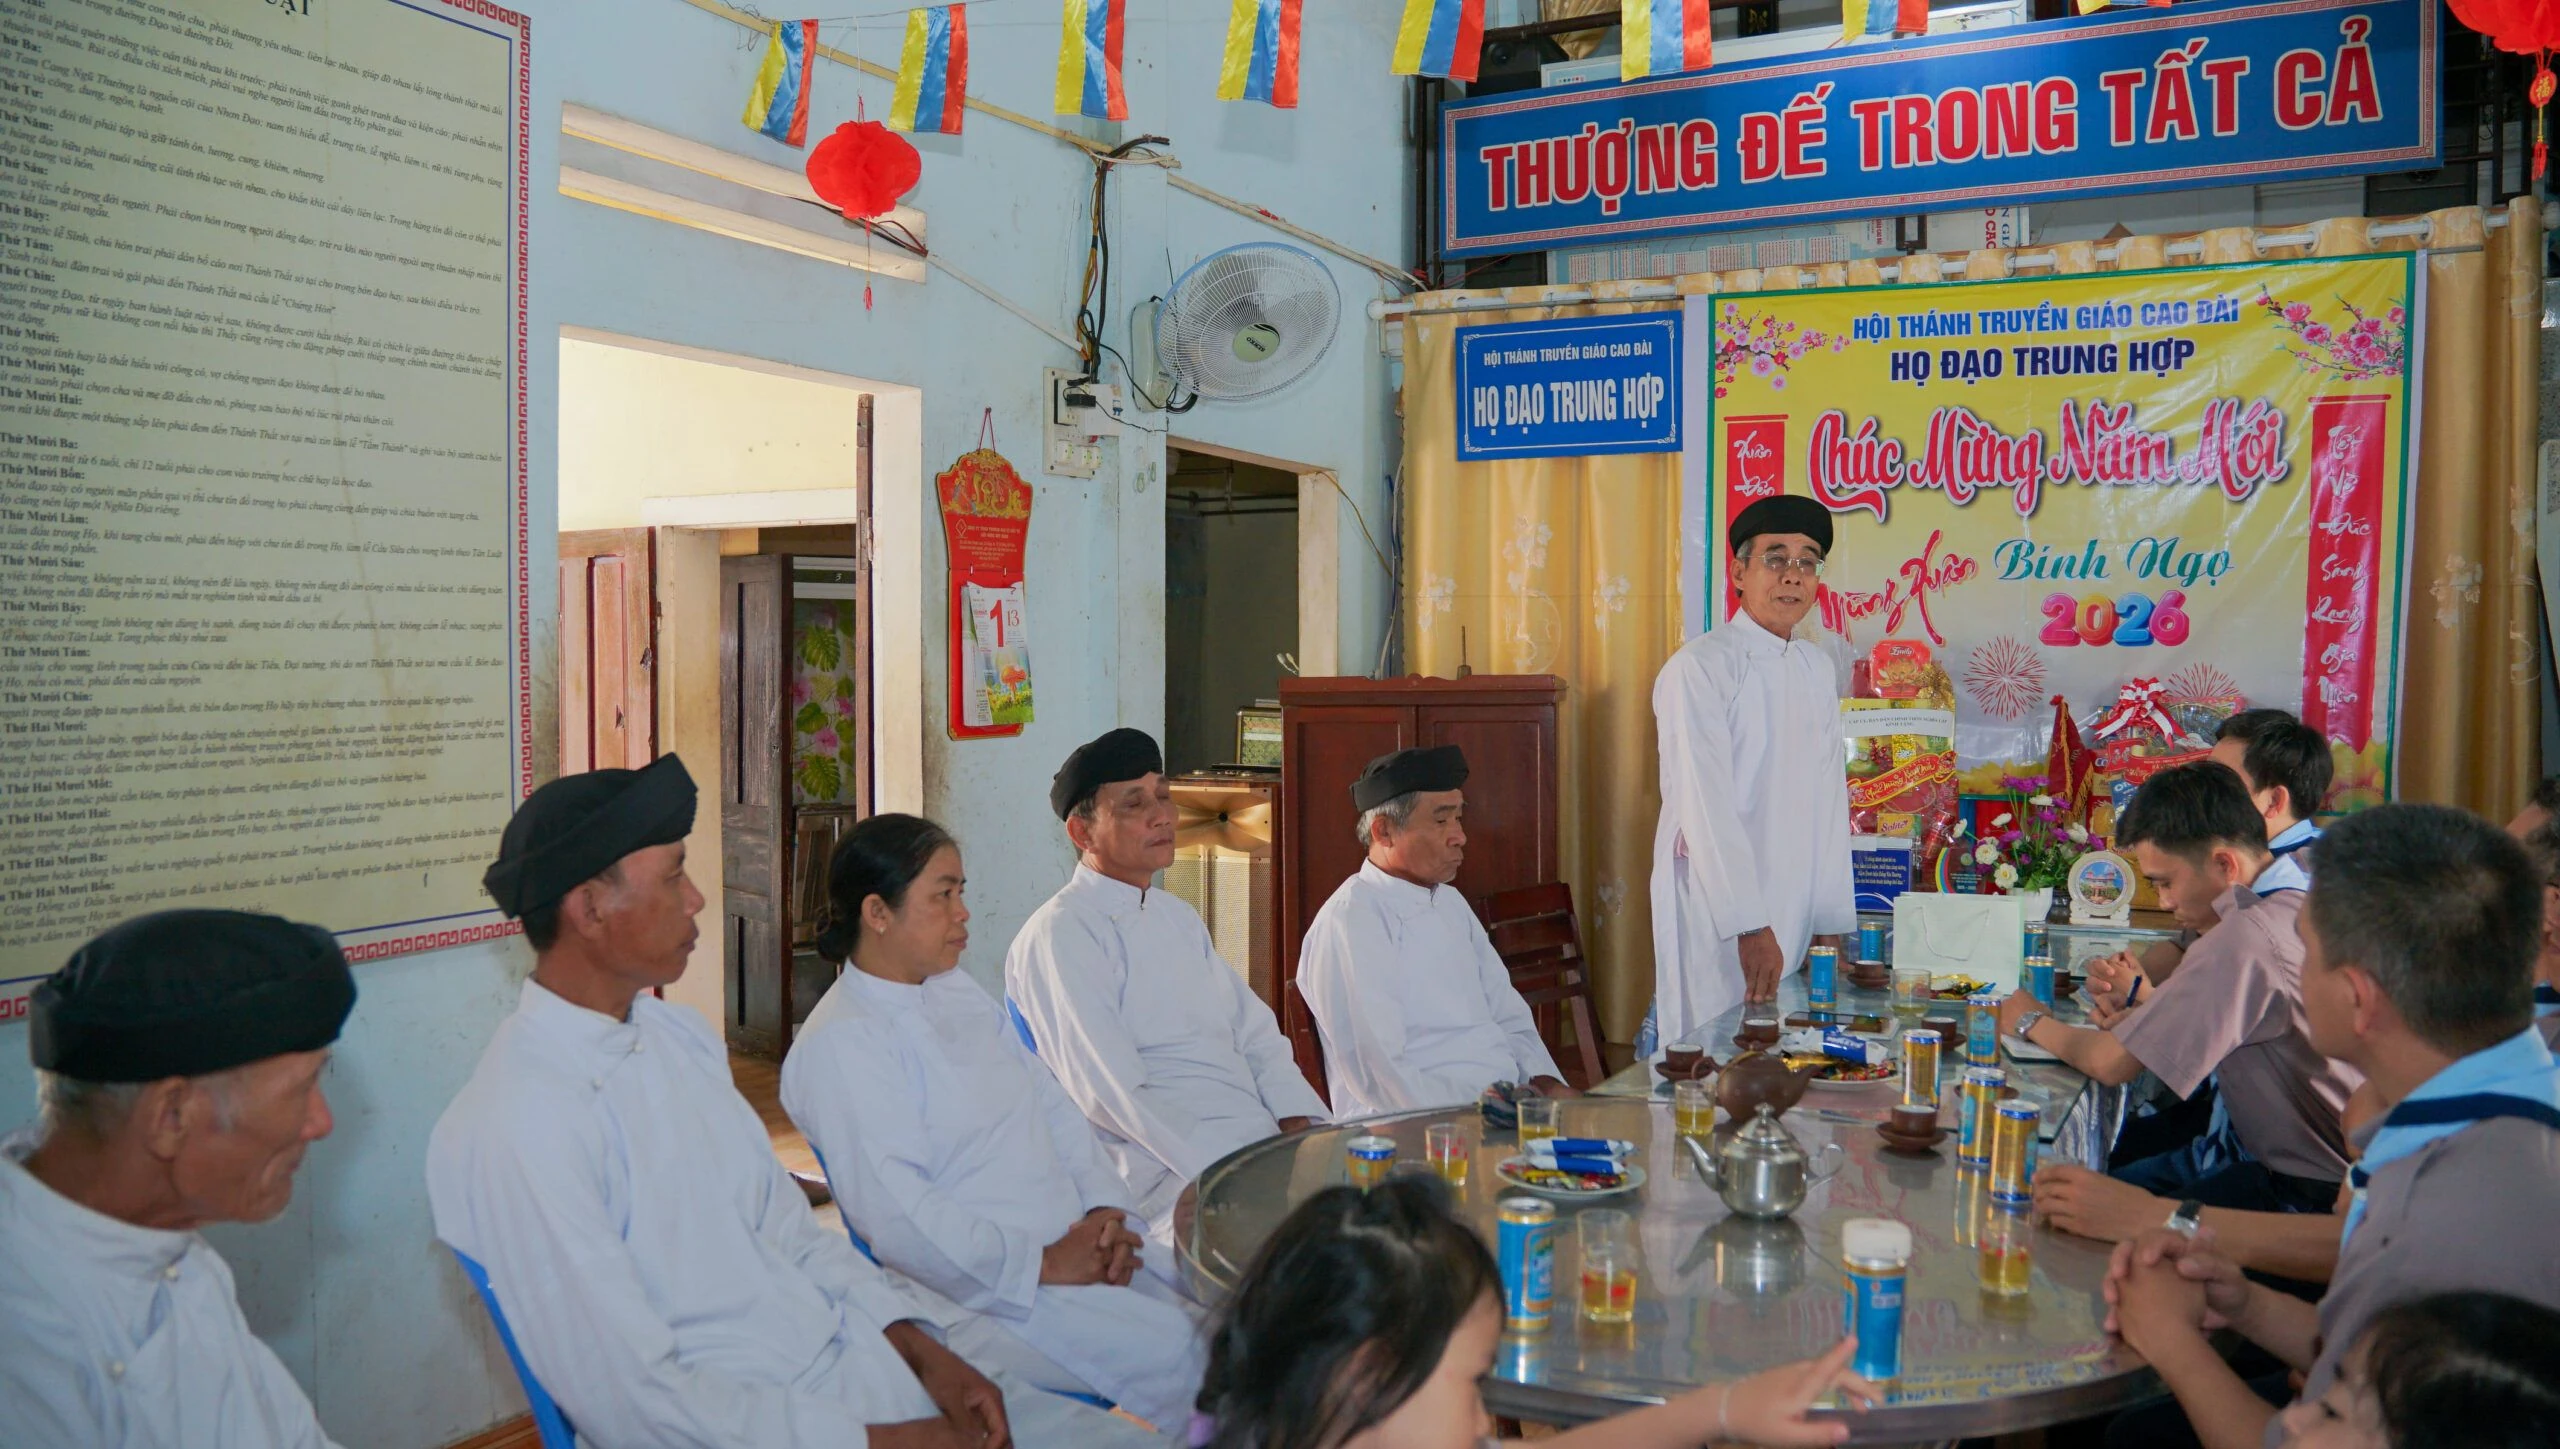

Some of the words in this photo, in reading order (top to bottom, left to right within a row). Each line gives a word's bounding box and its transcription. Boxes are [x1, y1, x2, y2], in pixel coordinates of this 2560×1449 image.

[0, 33, 18, 46] hứ
[23, 114, 54, 132] Năm:
[1480, 117, 1719, 216] THƯỢNG
[1739, 80, 1835, 182] ĐẾ
[1850, 75, 2079, 171] TRONG
[2099, 37, 2251, 148] TẤT
[2273, 14, 2384, 131] CẢ
[24, 237, 54, 252] Tám:
[1853, 313, 1891, 344] HỘI
[1897, 311, 1972, 337] THÁNH
[1979, 301, 2069, 335] TRUYỀN
[2076, 302, 2132, 330] GIÁO
[2140, 302, 2189, 326] CAO
[2196, 294, 2240, 324] ĐÀI
[0, 325, 22, 337] Thứ
[1484, 351, 1501, 368] HỘI
[1504, 348, 1537, 364] THÁNH
[1540, 342, 1580, 362] TRUYỀN
[1582, 342, 1607, 359] GIÁO
[1610, 343, 1631, 357] CAO
[1633, 339, 1652, 356] ĐÀI
[1890, 350, 1930, 387] HỌ
[1940, 348, 2002, 385] ĐẠO
[2013, 343, 2118, 377] TRUNG
[2129, 336, 2195, 378] HỢP
[0, 355, 22, 368] Thứ
[59, 363, 85, 378] Một:
[0, 386, 22, 398] Thứ
[59, 393, 83, 405] Hai:
[1473, 385, 1499, 436] HỌ
[1505, 382, 1545, 434] ĐẠO
[1550, 378, 1616, 423] TRUNG
[1623, 372, 1664, 429] HỢP
[0, 432, 24, 444] Thứ
[60, 438, 78, 450] Ba:
[1807, 408, 1901, 522] Chúc
[1908, 405, 2044, 517] Mừng
[2048, 397, 2174, 486] Năm
[2181, 398, 2288, 501] Mới
[0, 463, 24, 474] Thứ
[60, 466, 85, 480] Bốn:
[1, 510, 24, 521] Thứ
[27, 511, 58, 523] Mười
[61, 512, 89, 524] Lăm:
[1, 554, 24, 566] Thứ
[28, 556, 58, 567] Mười
[61, 557, 85, 568] Sáu:
[1994, 539, 2111, 580] Bính
[2126, 537, 2234, 587] Ngọ
[2, 601, 25, 612] Thứ
[989, 599, 1004, 647] 1
[1007, 609, 1020, 627] 13
[2039, 589, 2190, 647] 2026
[2, 647, 26, 657] Thứ
[62, 647, 91, 657] Tám:
[4, 692, 27, 703] Thứ
[5, 723, 28, 734] Thứ
[31, 722, 51, 732] Hai
[6, 783, 29, 795] Thứ
[32, 782, 52, 793] Hai
[7, 813, 31, 825] Thứ
[34, 812, 53, 823] Hai
[89, 808, 111, 819] Hai:
[8, 859, 32, 871] Thứ
[35, 857, 54, 868] Hai
[89, 853, 108, 864] Ba:
[9, 890, 33, 901] Thứ
[36, 888, 55, 898] Hai
